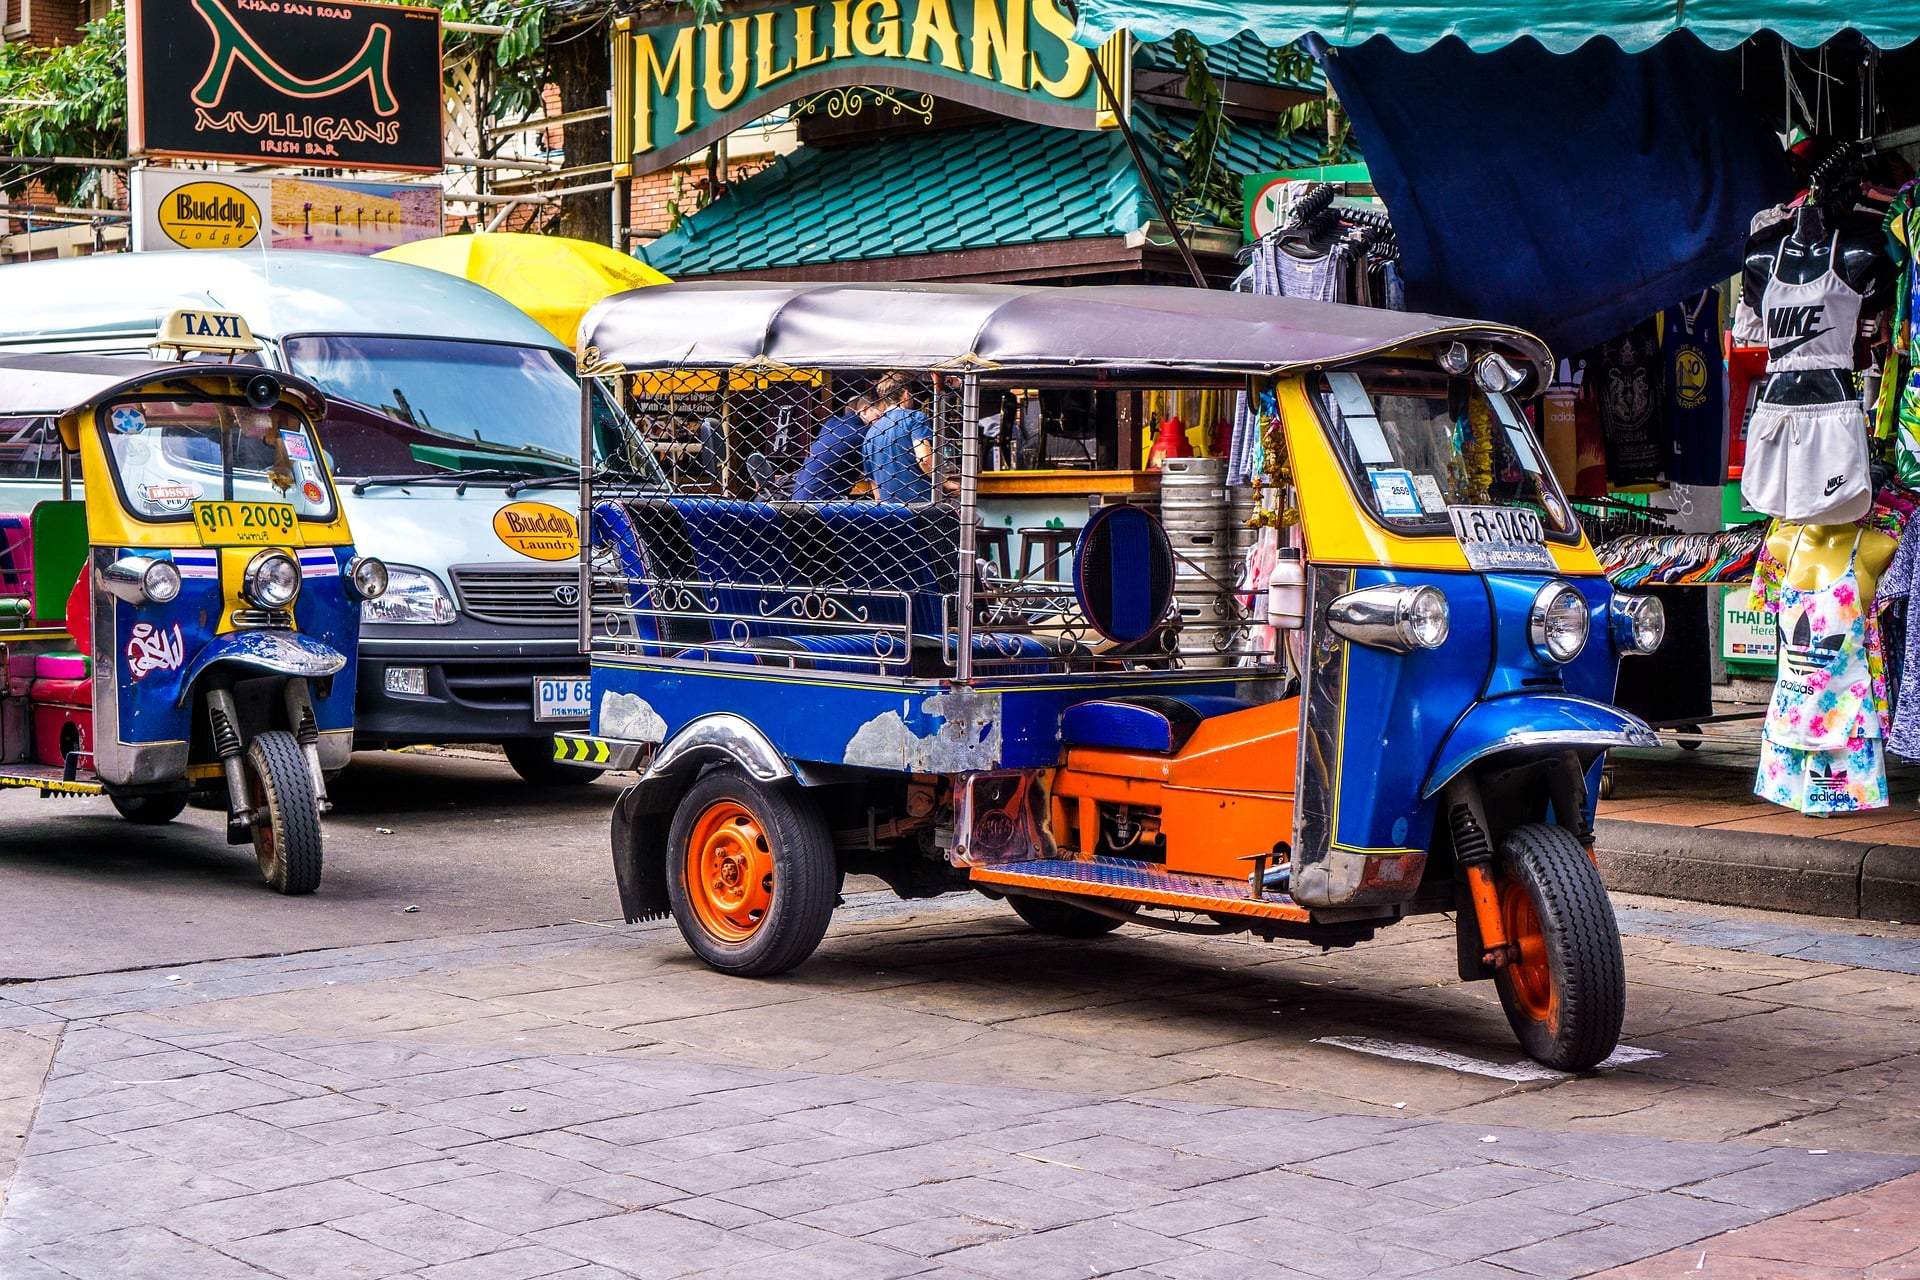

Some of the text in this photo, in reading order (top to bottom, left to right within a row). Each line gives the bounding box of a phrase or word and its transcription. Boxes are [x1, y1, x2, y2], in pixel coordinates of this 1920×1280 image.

[237, 0, 352, 20] KHAO SAN ROAD
[632, 0, 1092, 154] MULLIGANS
[194, 107, 400, 144] MULLIGANS
[260, 139, 339, 157] IRISH BAR
[176, 193, 245, 229] Buddy
[179, 229, 244, 245] Lodge
[180, 313, 242, 338] TAXI
[1767, 305, 1826, 339] NIKE
[1826, 474, 1844, 489] NIKE
[240, 505, 293, 528] 2009
[504, 511, 574, 538] Buddy
[519, 539, 575, 551] Laundry
[1727, 610, 1760, 625] THAI
[574, 681, 591, 702] 68
[1780, 679, 1815, 696] adidas
[1809, 790, 1850, 802] adidas
